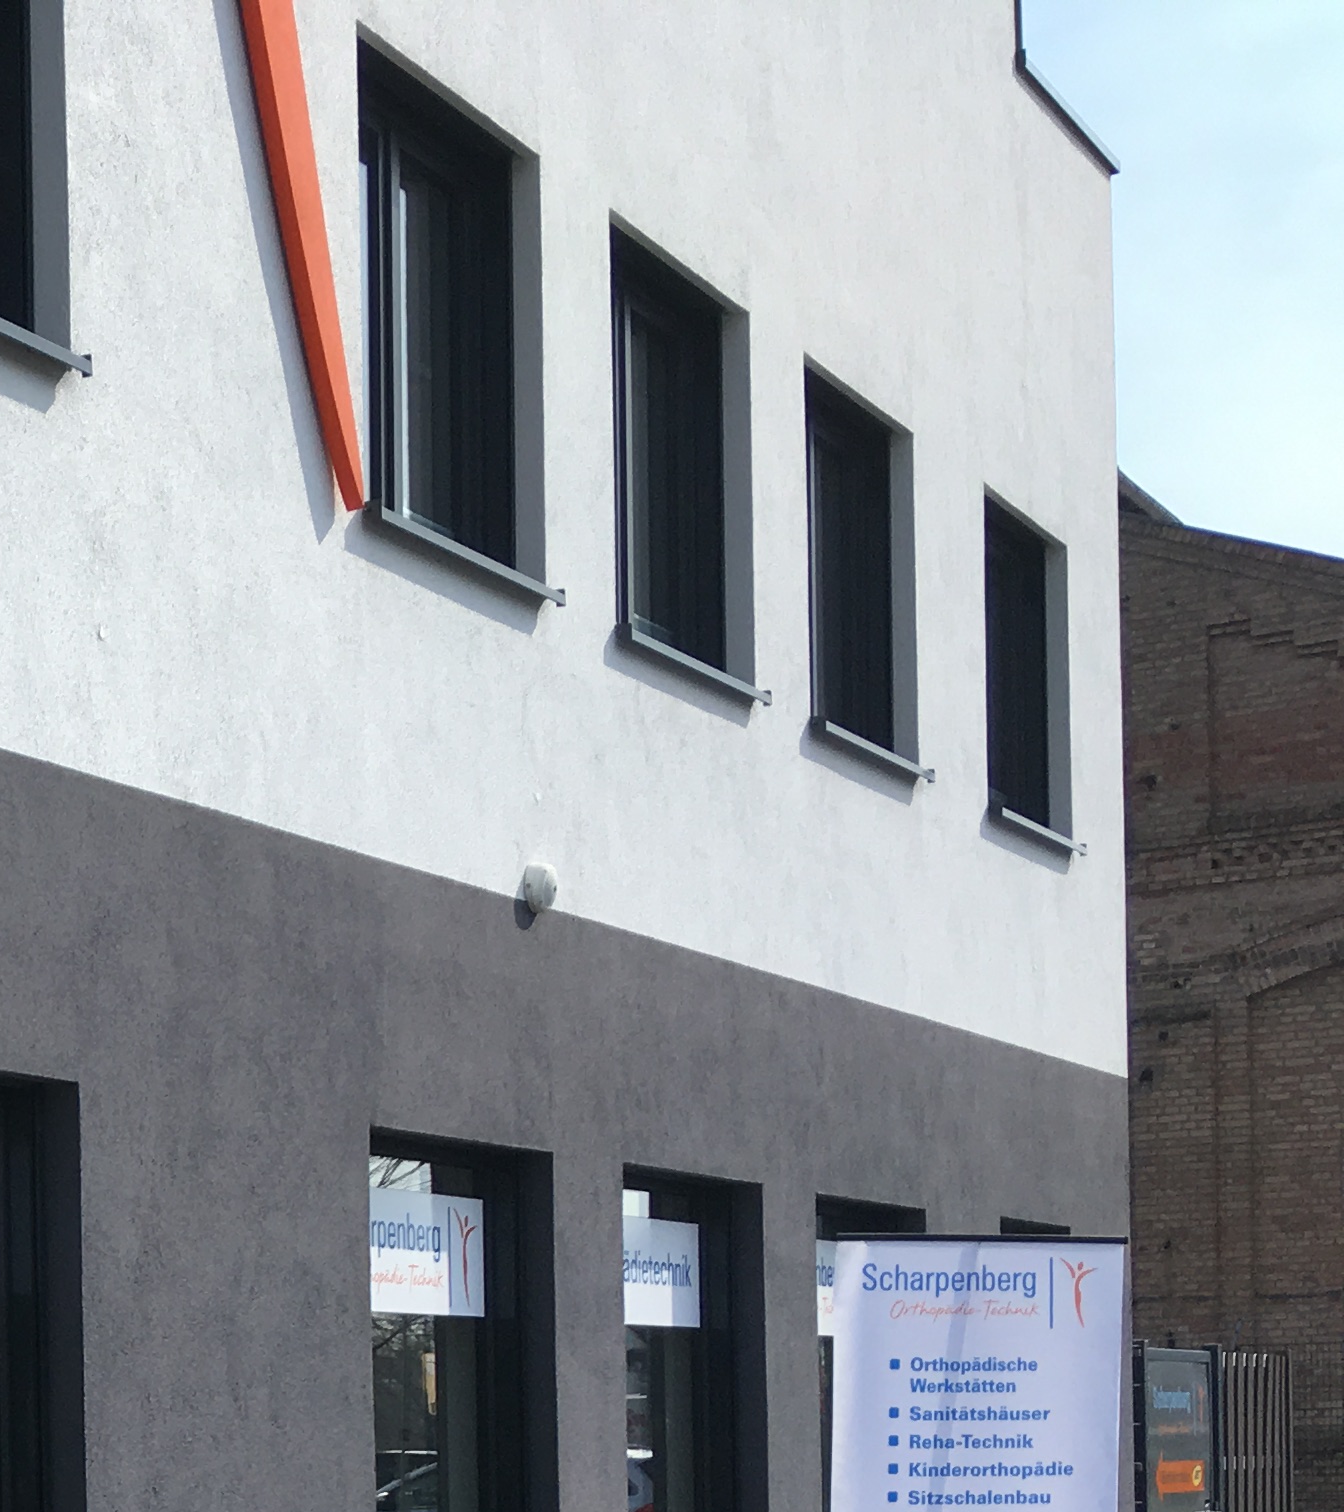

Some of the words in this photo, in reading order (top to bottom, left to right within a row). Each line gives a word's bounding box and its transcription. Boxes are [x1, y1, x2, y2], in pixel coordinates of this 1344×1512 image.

[862, 1262, 1037, 1299] Scharpenberg
[890, 1299, 1040, 1324] Orthopädie-Technik
[910, 1357, 1038, 1375] Orthopädische
[910, 1378, 1017, 1394] Werkstätten
[909, 1406, 1051, 1422] Sanitätshäuser
[909, 1434, 1034, 1450] Reha-Technik
[908, 1461, 1074, 1480] Kinderorthopädie
[908, 1490, 1051, 1505] Sitzschalenbau
